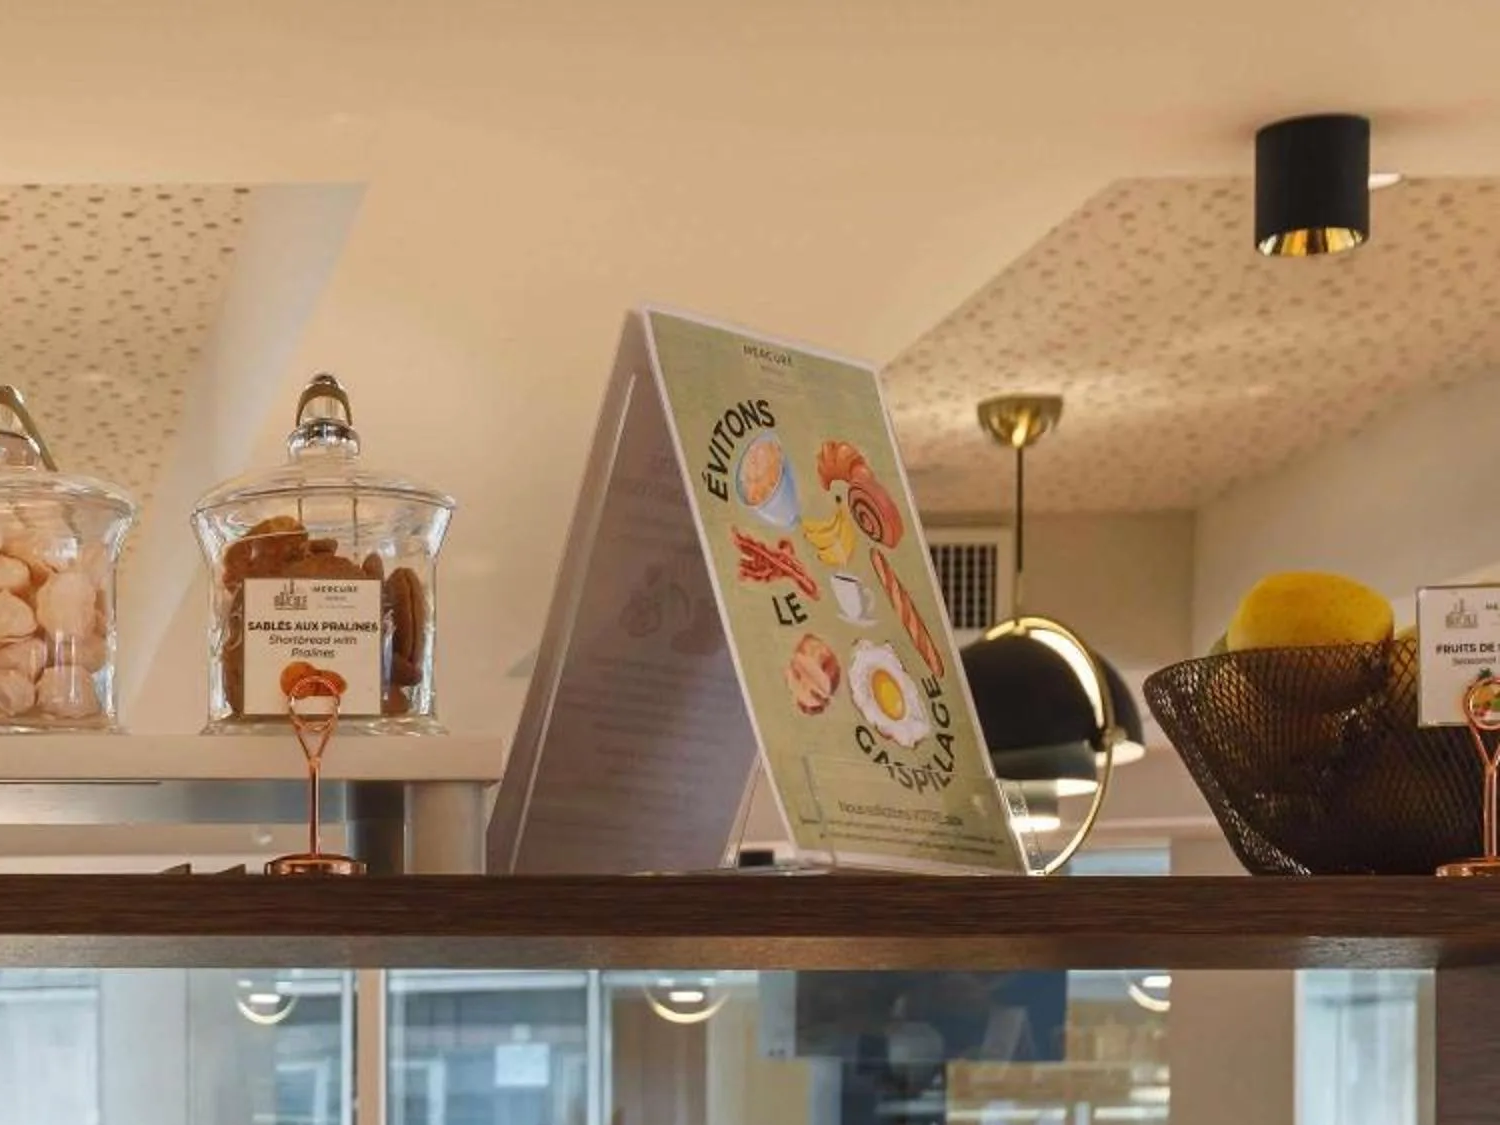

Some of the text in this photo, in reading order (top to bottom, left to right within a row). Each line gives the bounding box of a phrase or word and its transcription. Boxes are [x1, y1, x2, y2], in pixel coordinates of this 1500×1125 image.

[701, 399, 776, 502] ÉVITONS
[772, 592, 808, 626] LE
[294, 621, 319, 631] AUX
[321, 621, 378, 632] PRALINES
[269, 634, 330, 645] Shortbread
[1436, 643, 1495, 655] FRUITS DE
